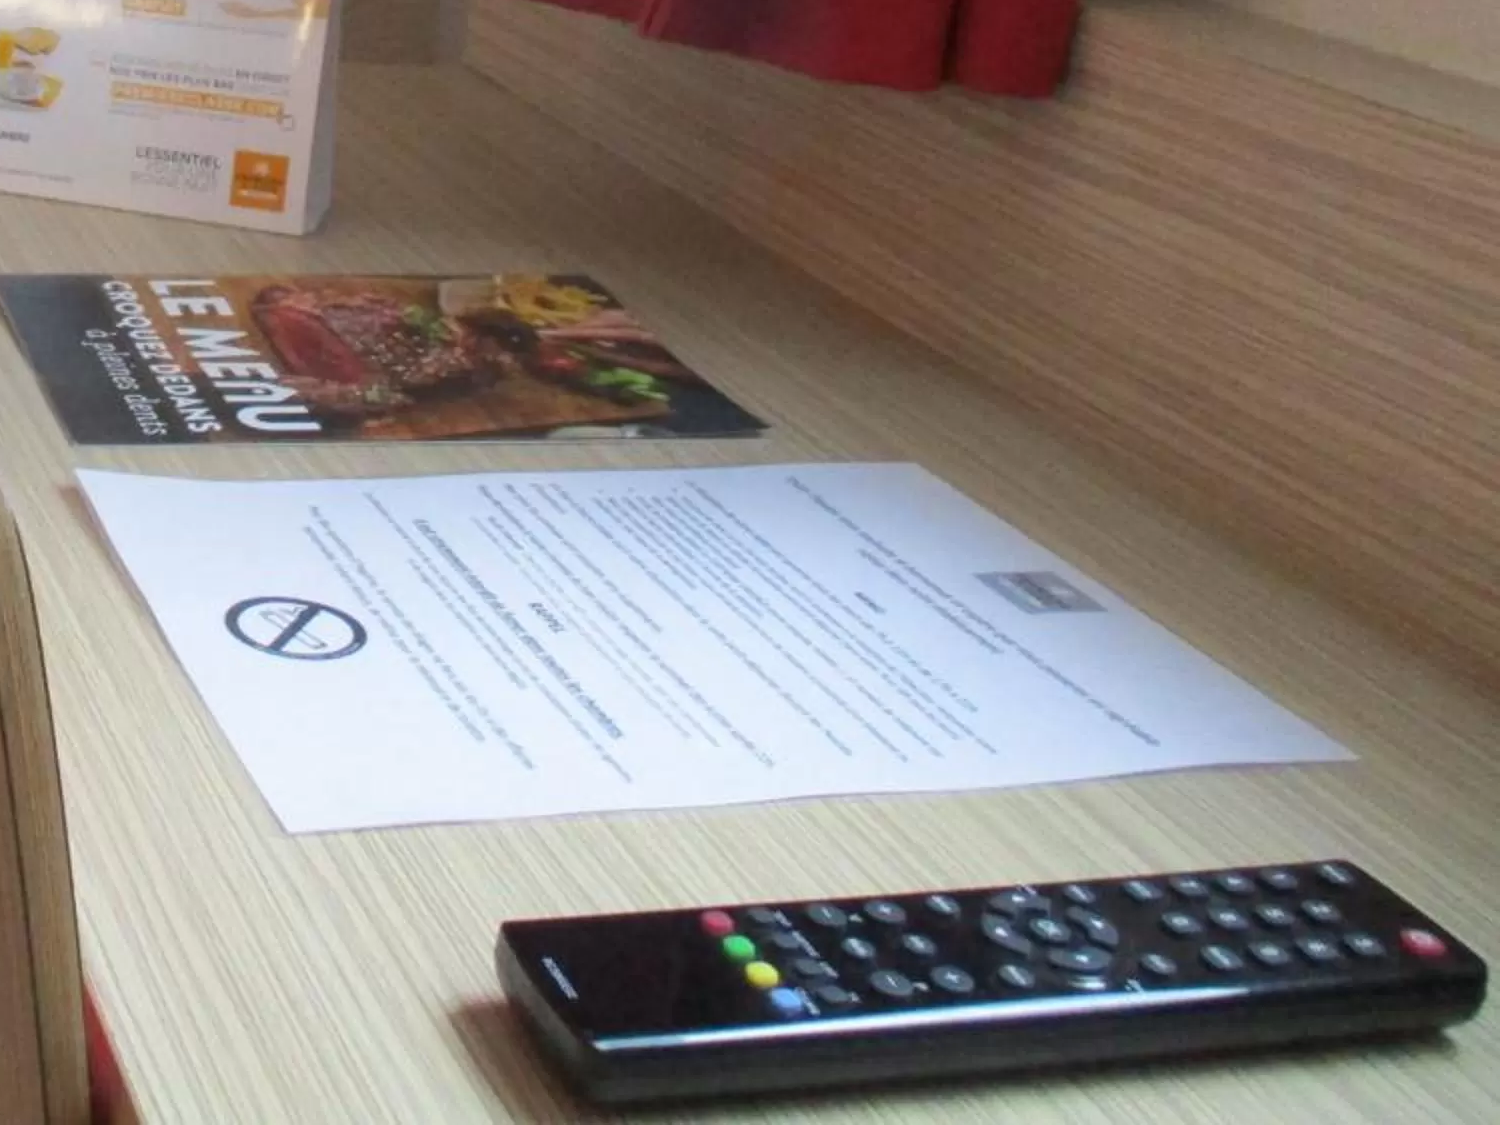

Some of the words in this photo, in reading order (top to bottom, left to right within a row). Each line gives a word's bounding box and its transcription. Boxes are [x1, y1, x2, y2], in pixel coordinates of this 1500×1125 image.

[148, 280, 234, 316] LE
[85, 328, 117, 339] à
[102, 281, 174, 360] CROQUEZ
[149, 364, 222, 433] DEDANS
[81, 339, 140, 390] pleines
[177, 327, 322, 432] MENU
[122, 393, 167, 436] dents
